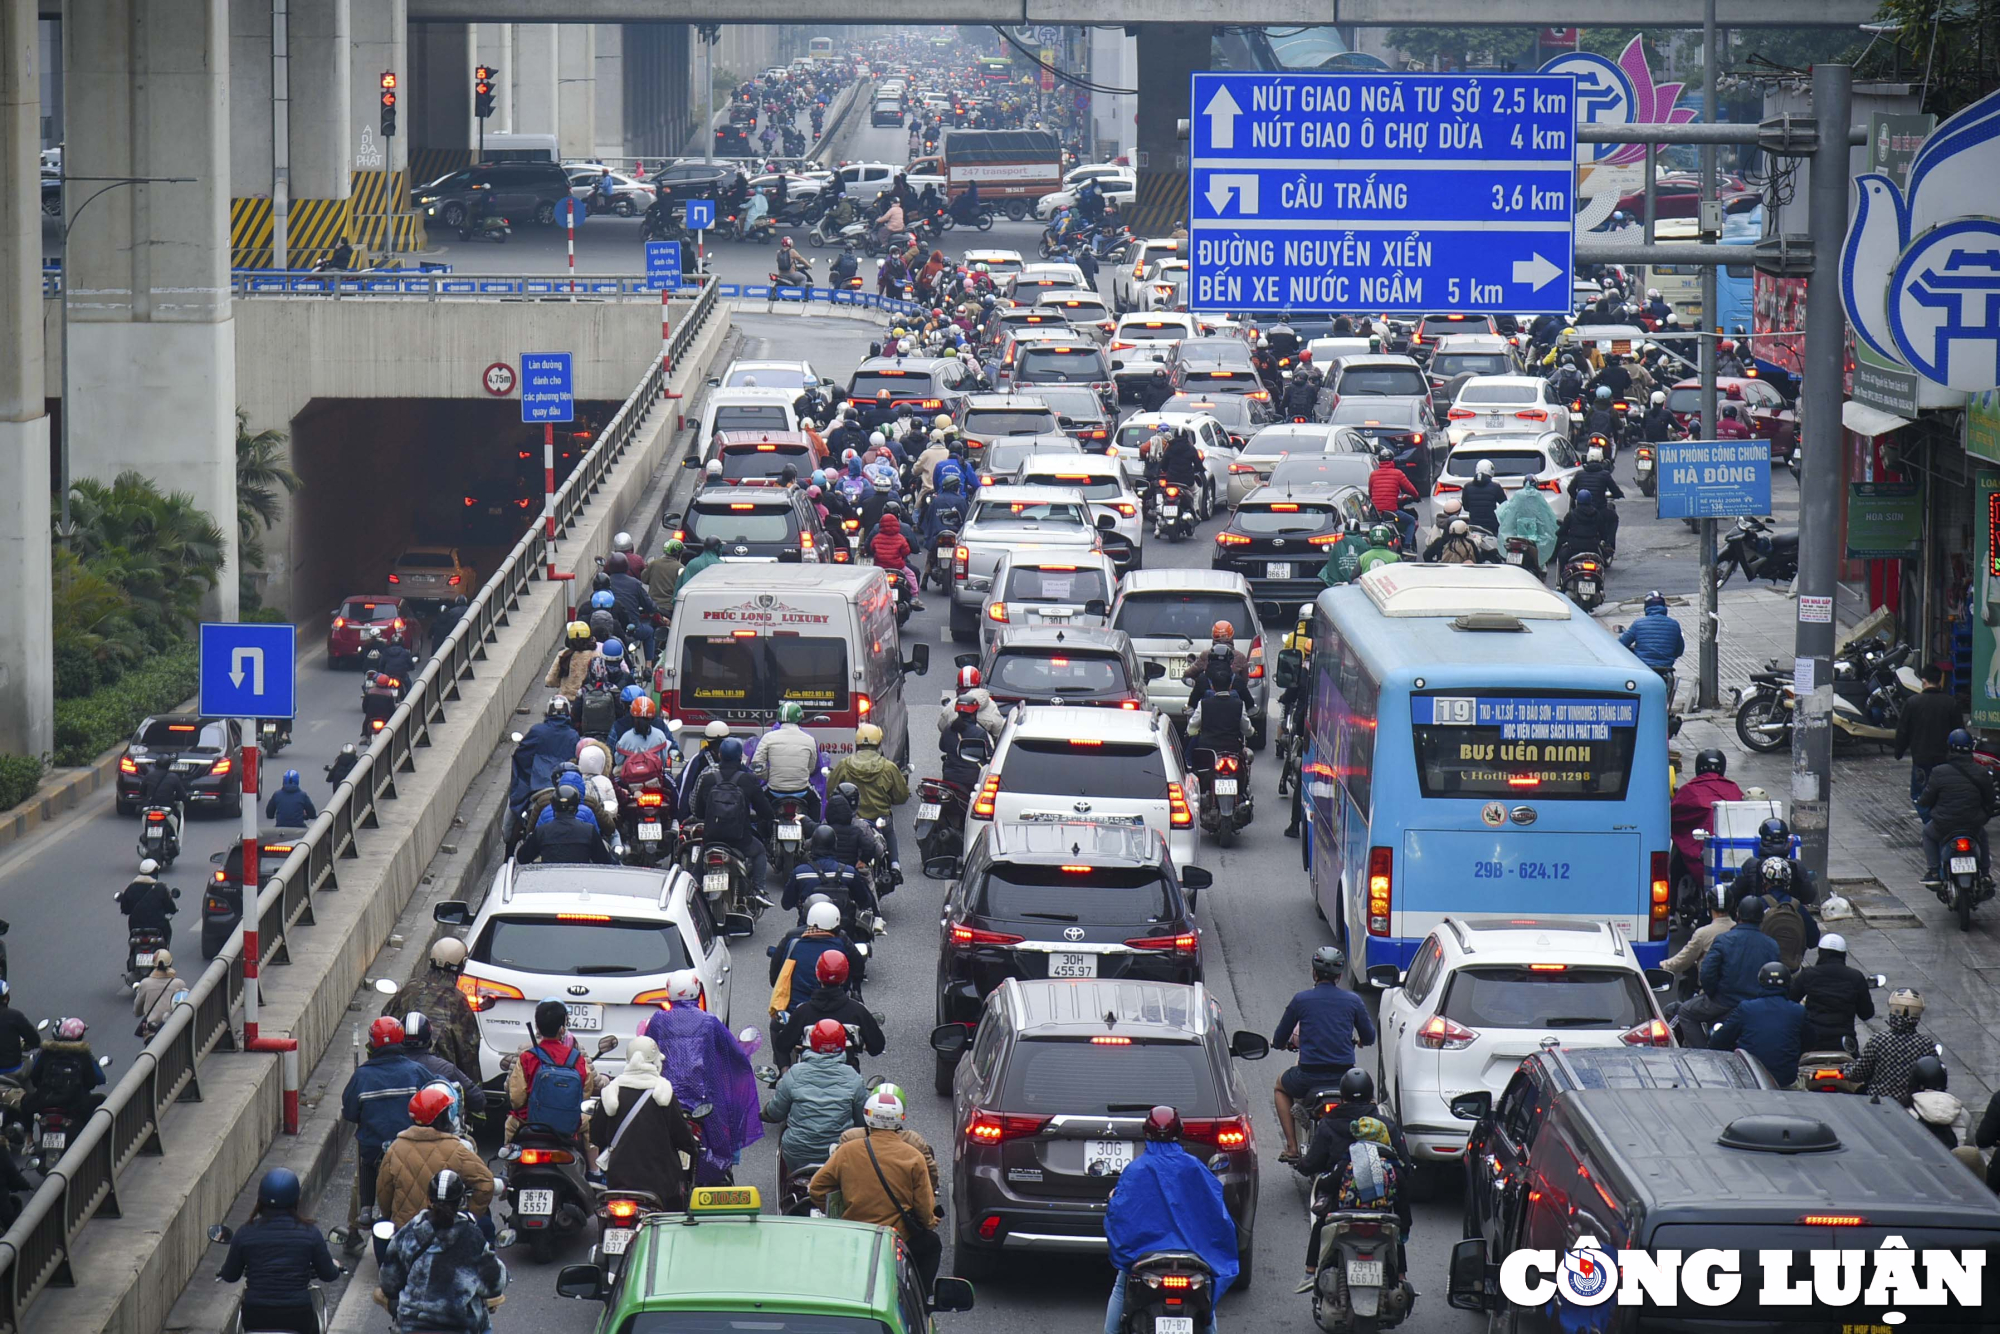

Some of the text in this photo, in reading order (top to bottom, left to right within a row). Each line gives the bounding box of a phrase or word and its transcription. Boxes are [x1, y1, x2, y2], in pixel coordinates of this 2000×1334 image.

[1253, 79, 1566, 115] NÚT GIAO NGÃ TƯ SỞ 2,5 km
[1253, 116, 1565, 153] NÚT GIAO Ô CHỢ DỪA 4 km
[983, 167, 1028, 177] transport
[1282, 173, 1564, 212] CẦU TRẮNG 3,6 km
[1198, 230, 1432, 267] ĐƯỜNG NGUYỄN XIỂN
[1199, 268, 1503, 304] BẾN XE NƯỚC NGẦM 5 km
[529, 360, 562, 371] Làn đường
[533, 376, 561, 385] dành cho
[524, 391, 571, 402] các phương tiện
[533, 405, 561, 418] quay đầu
[1660, 443, 1768, 463] VĂN PHÒNG CÔNG CHỨNG
[1673, 465, 1756, 484] HÀ ĐÔNG
[703, 610, 829, 623] PHÚC LONG LUXURY
[1439, 701, 1470, 721] 19
[1567, 705, 1597, 721] VINHOMES
[1617, 705, 1632, 721] LONG
[1504, 721, 1609, 740] HỌC VIỆN CHÍNH SÁCH VÀ PHÁT TRIỂN
[1460, 741, 1591, 762] BUS LIÊN NINH
[1472, 771, 1591, 782] Hotline 1900.1298
[1474, 861, 1570, 879] 29B 624.12
[1063, 955, 1083, 965] 30H
[1054, 966, 1091, 978] 455.97
[569, 986, 586, 994] KIA
[1097, 1141, 1122, 1156] 30G
[524, 1192, 548, 1202] 36-P4
[712, 1192, 750, 1204] 1055
[523, 1202, 547, 1213] 5557
[1350, 1273, 1380, 1285] 466.71
